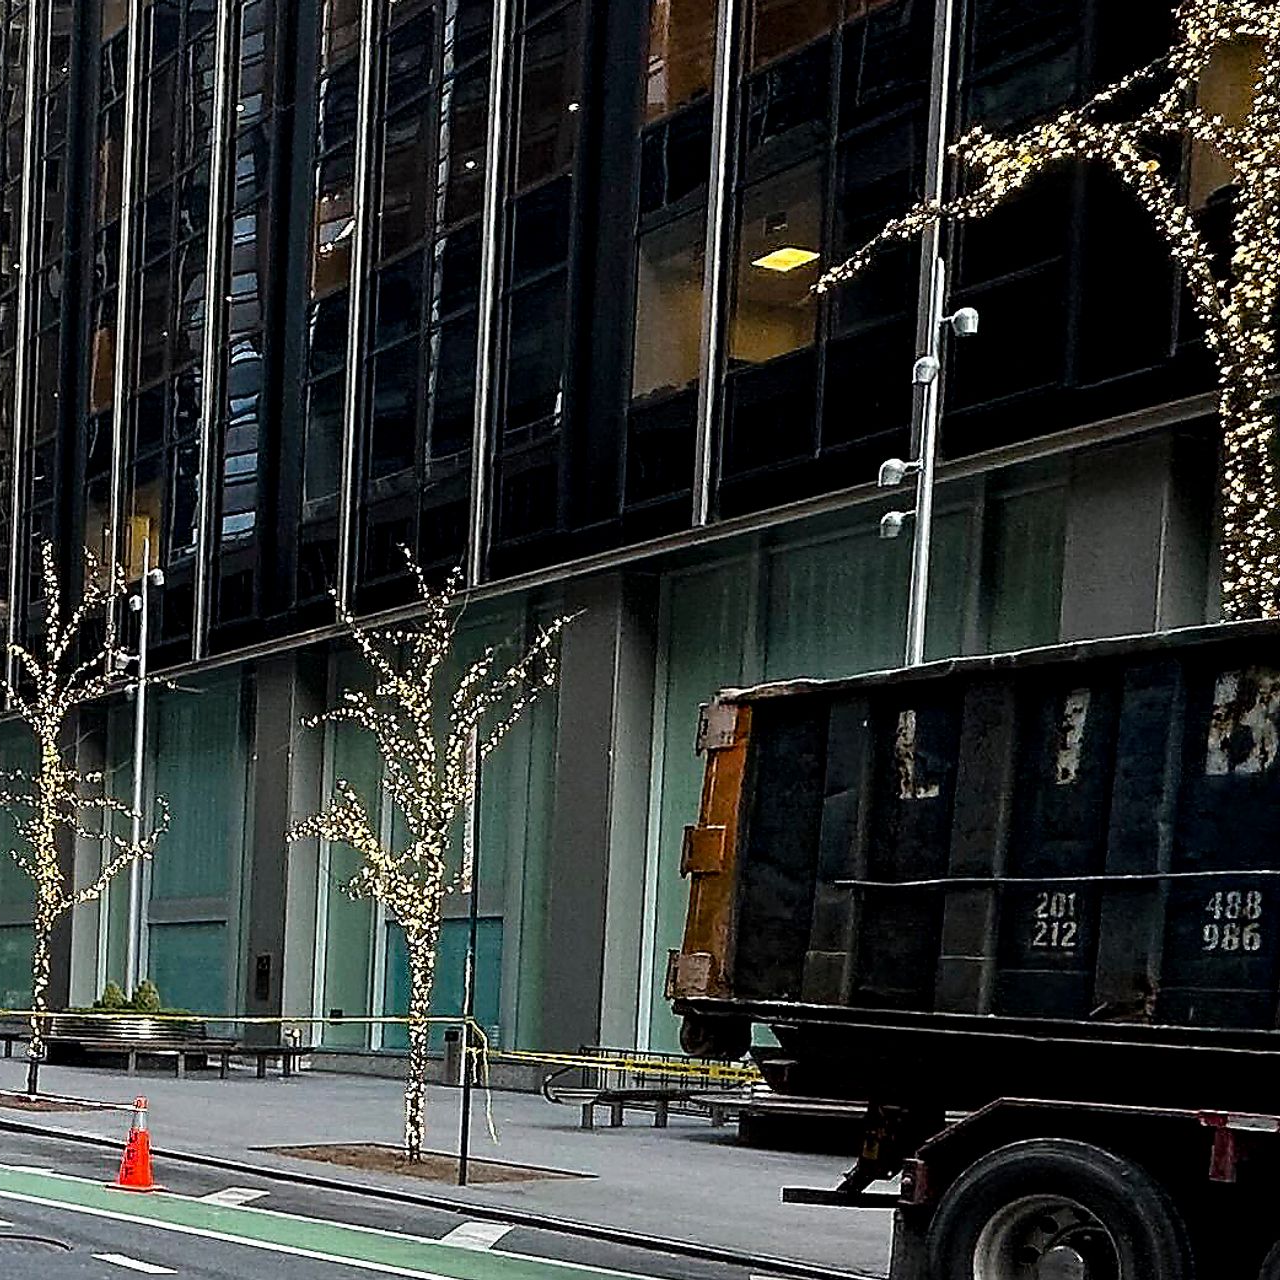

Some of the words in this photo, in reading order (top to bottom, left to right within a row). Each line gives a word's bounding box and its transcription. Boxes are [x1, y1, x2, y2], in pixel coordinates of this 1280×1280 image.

[1034, 891, 1076, 919] 201
[1205, 890, 1262, 920] 488
[1032, 921, 1078, 947] 212
[1201, 922, 1262, 951] 986
